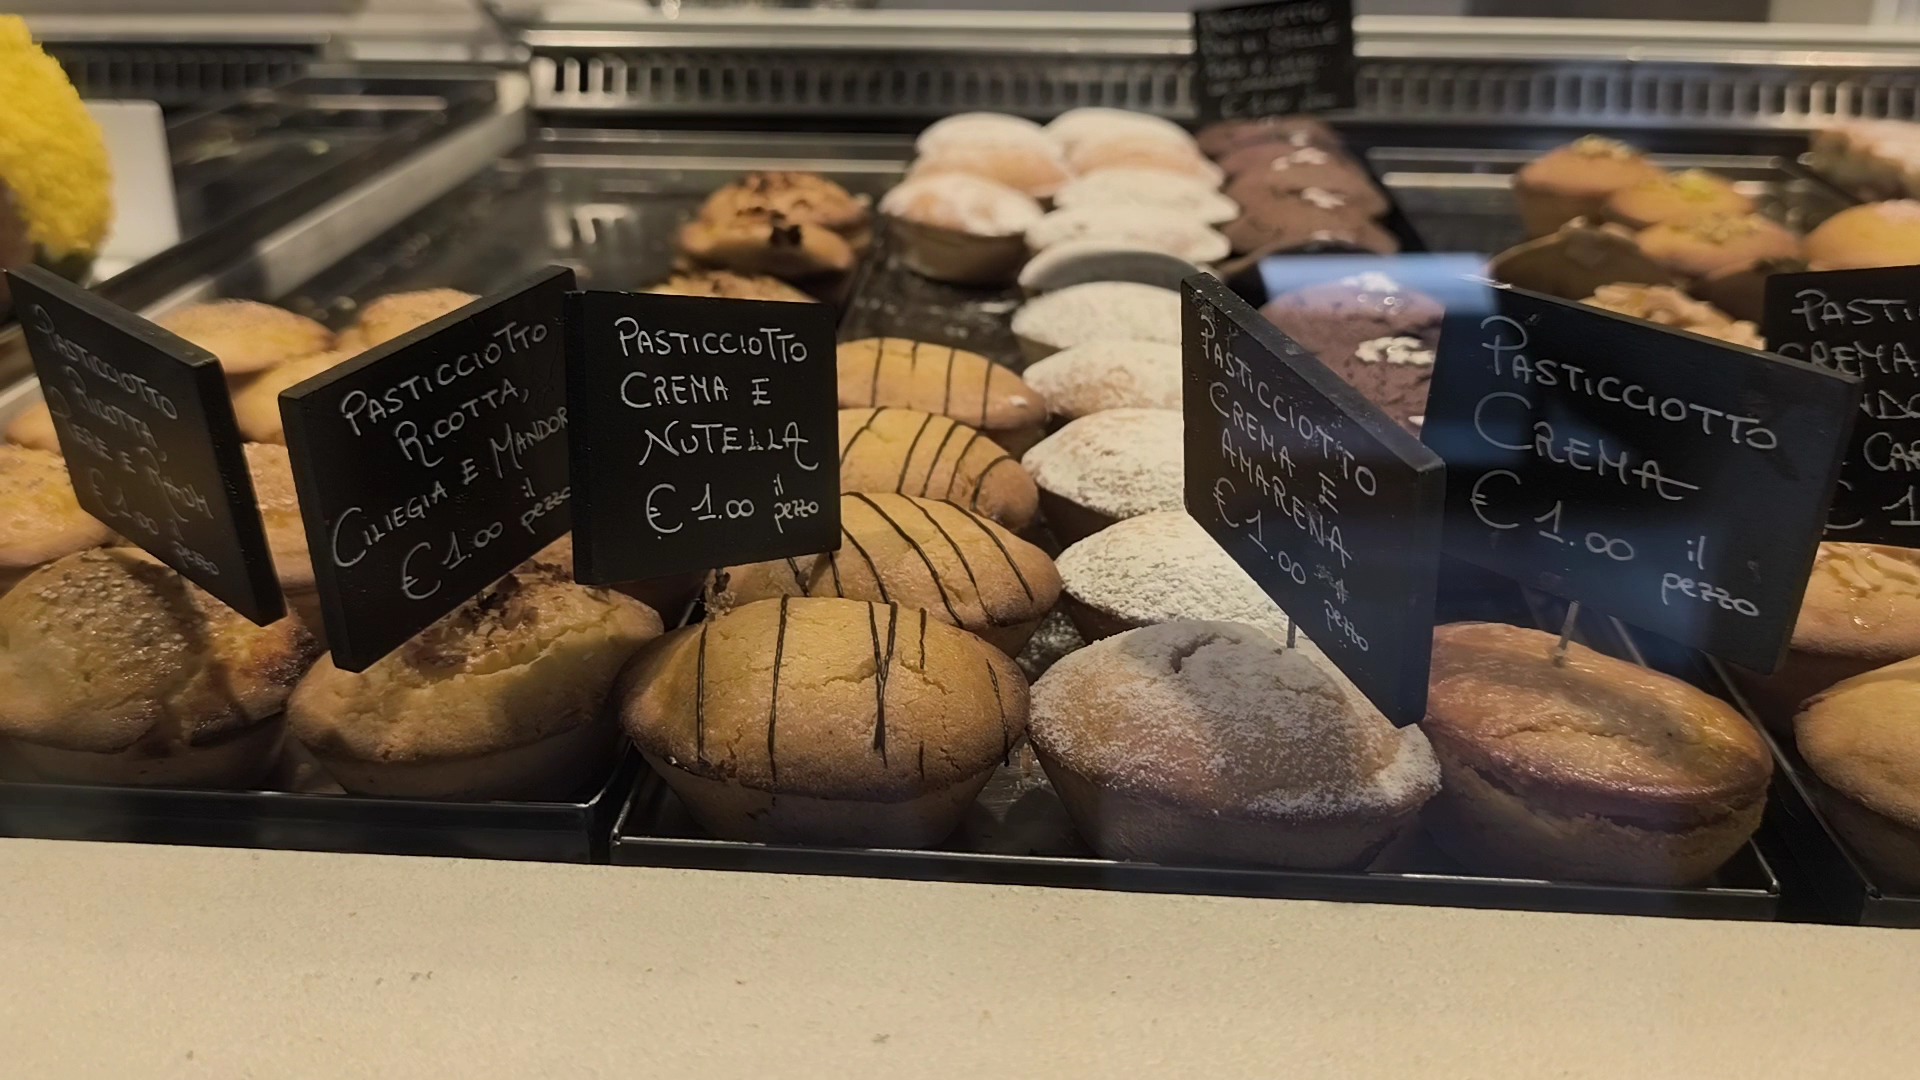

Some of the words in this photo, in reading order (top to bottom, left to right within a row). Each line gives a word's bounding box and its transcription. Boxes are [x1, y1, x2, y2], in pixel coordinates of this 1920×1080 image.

[1791, 289, 1920, 331] PASTI
[33, 303, 178, 420] PASTICCIOTTO
[614, 316, 808, 364] PASTICCIOTTO
[340, 320, 549, 436] PASTICCIOTTO
[620, 371, 730, 409] CREMA
[751, 377, 772, 406] E
[1480, 315, 1779, 450] PASTICCIOTTO
[1200, 314, 1376, 497] PASTICCIOTTO
[120, 451, 137, 474] E
[638, 420, 819, 471] NUTELLA
[1209, 381, 1297, 478] CREMA
[1318, 471, 1339, 514] E
[1474, 391, 1701, 501] CREMA
[332, 480, 448, 568] CILIEGIA
[461, 458, 480, 486] E
[489, 405, 569, 479] MANDOR
[521, 477, 536, 498] il
[646, 483, 683, 534] €
[691, 483, 755, 521] 1.00
[773, 473, 784, 497] il
[1221, 427, 1353, 570] AMARENA
[774, 499, 820, 534] pezzo
[1212, 476, 1240, 529] €
[1246, 509, 1307, 585] 1.00
[1469, 469, 1521, 530] €
[1534, 500, 1635, 562] 1.00
[400, 541, 442, 600] €
[442, 521, 504, 571] 1.00
[1687, 535, 1706, 570] il
[1661, 572, 1761, 617] pezzo
[1323, 599, 1369, 652] pezzo
